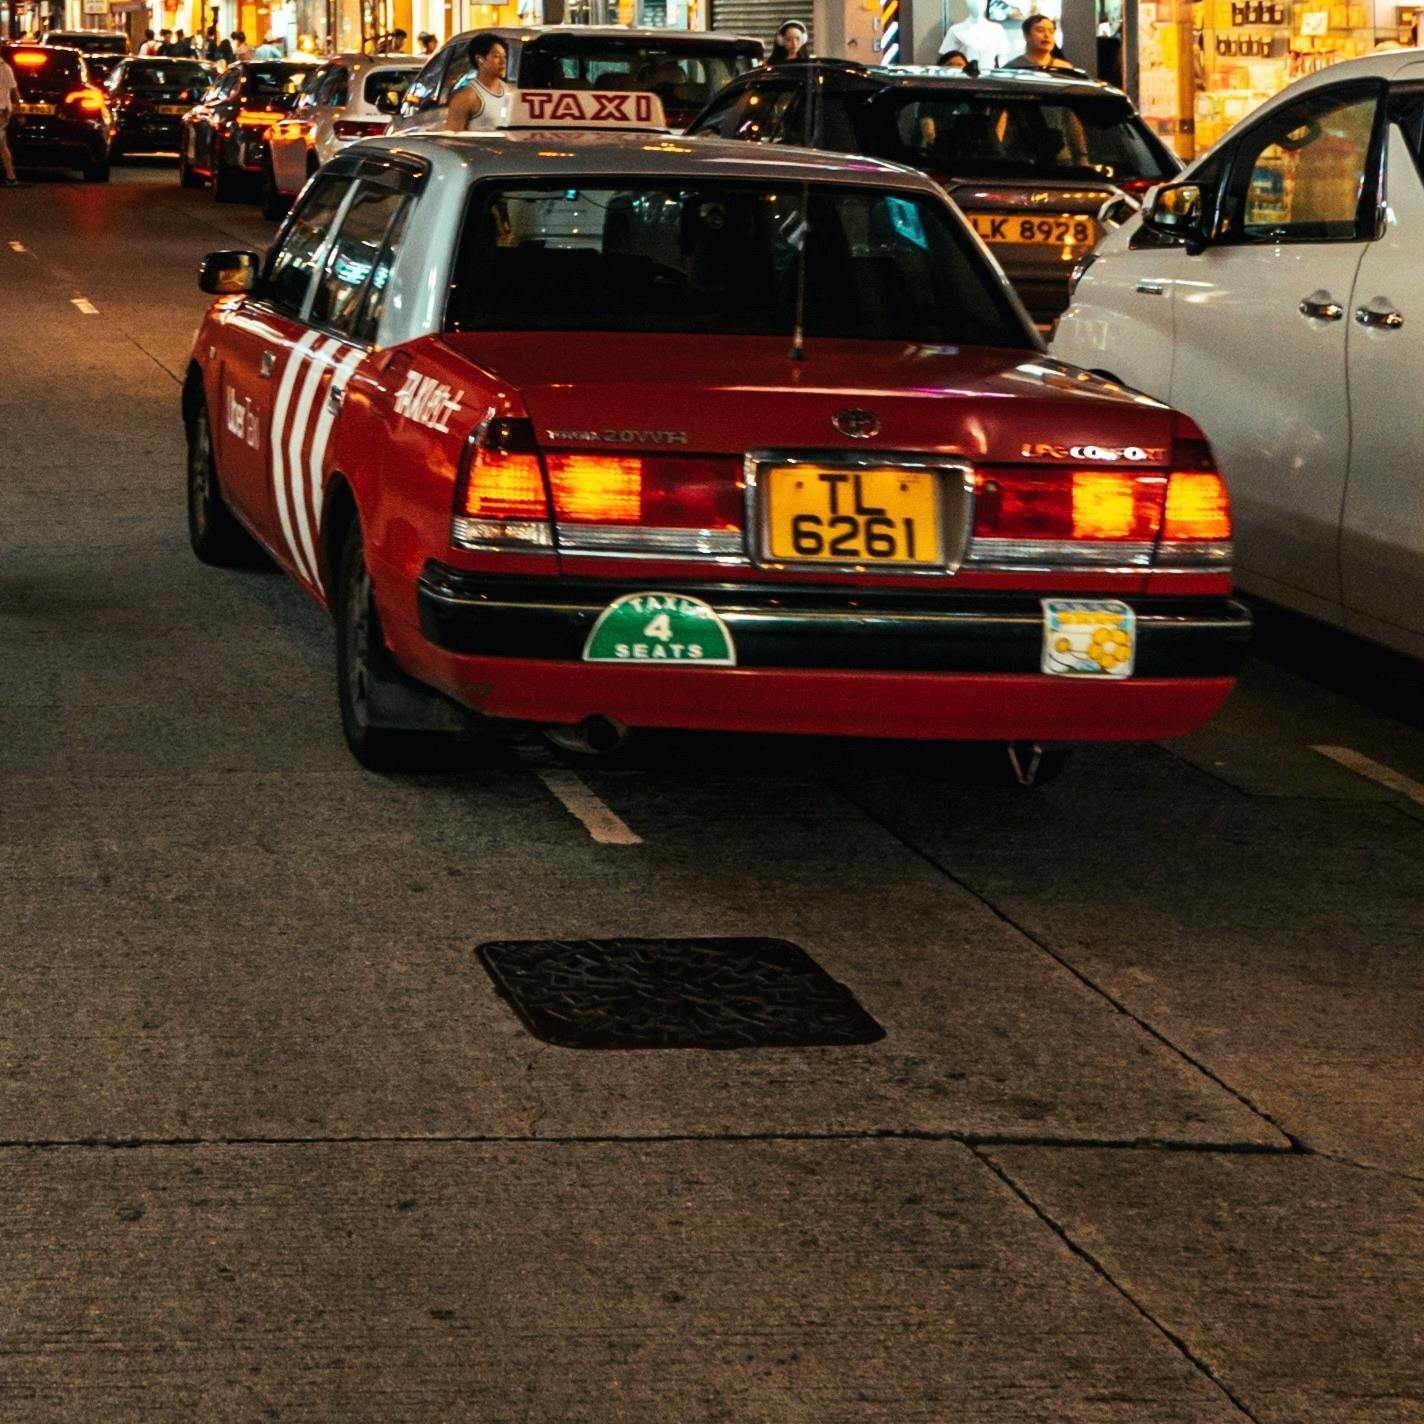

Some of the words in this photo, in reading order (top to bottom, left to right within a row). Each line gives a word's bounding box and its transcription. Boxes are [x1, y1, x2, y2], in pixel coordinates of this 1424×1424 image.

[521, 92, 652, 121] TAXI
[1020, 220, 1088, 242] 8928
[818, 473, 886, 516] TL
[792, 514, 915, 559] 6261
[643, 613, 673, 641] 4
[614, 643, 704, 658] SEATS
